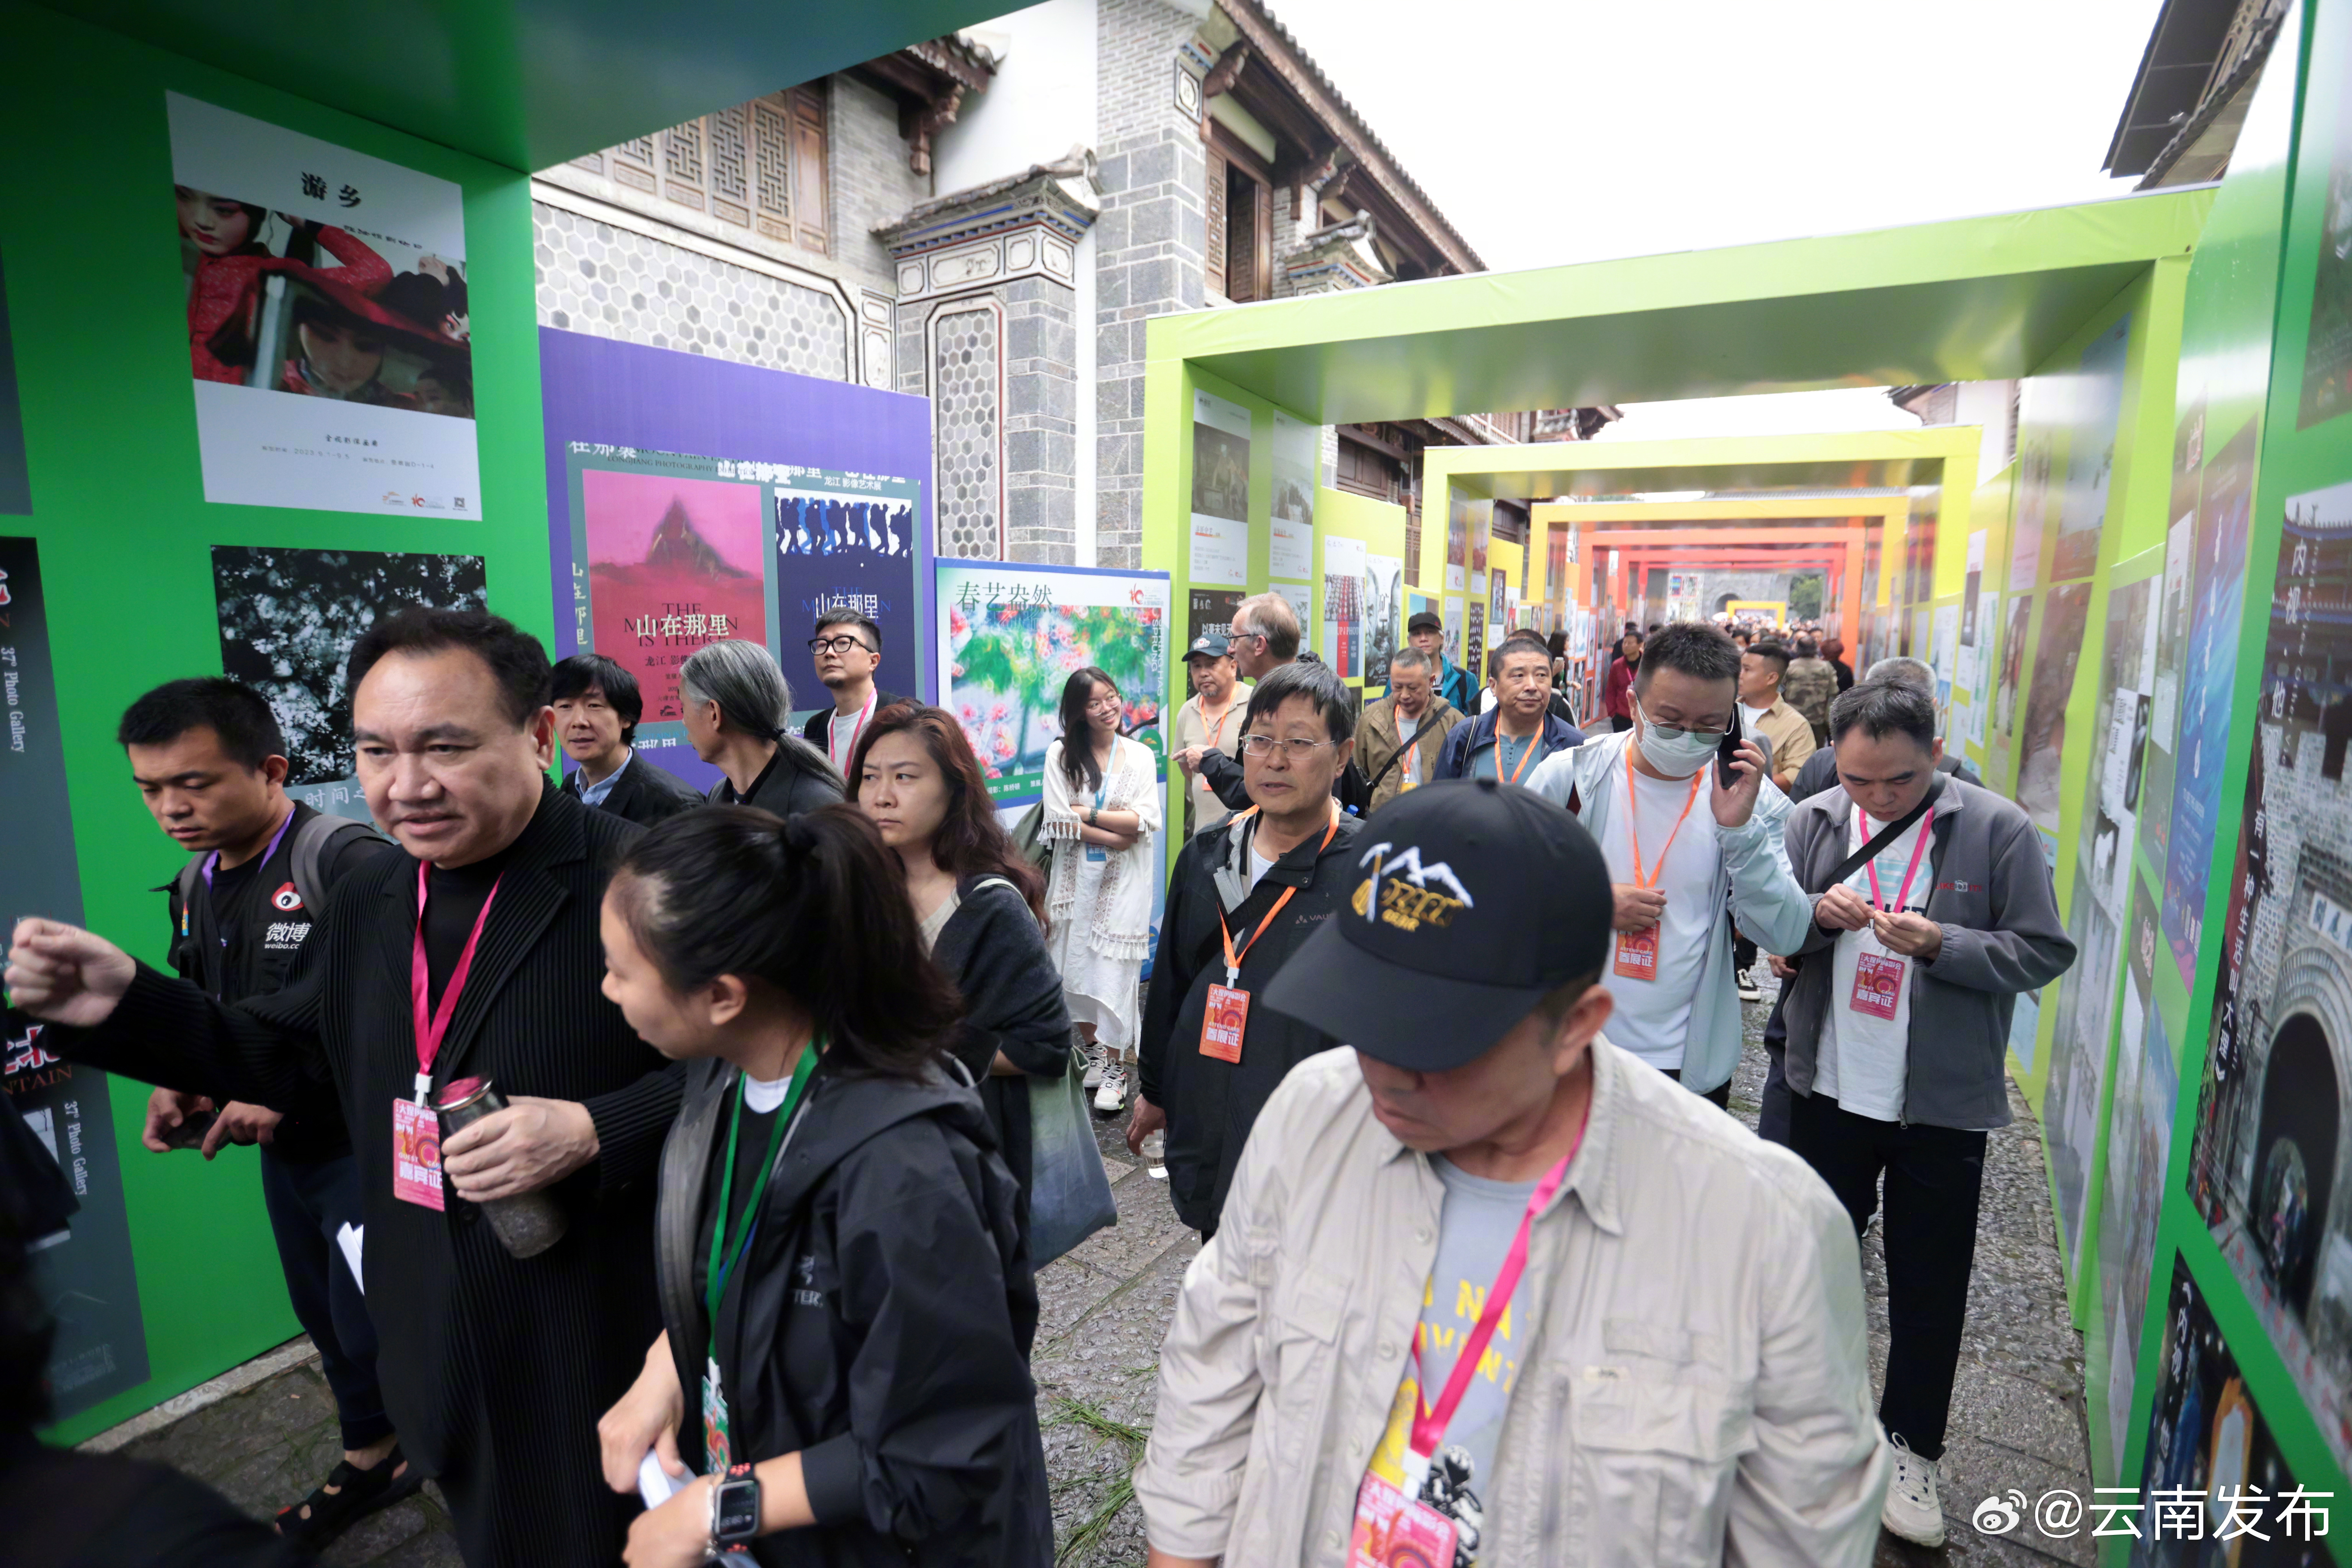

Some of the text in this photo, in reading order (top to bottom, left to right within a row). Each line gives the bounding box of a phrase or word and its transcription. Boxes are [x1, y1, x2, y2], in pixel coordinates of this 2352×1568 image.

[301, 171, 362, 208] 游乡
[607, 455, 653, 466] LONGJIANG
[655, 459, 714, 472] PHOTOGRAPHY
[824, 475, 882, 491] 龙江 影像艺术展
[956, 581, 1053, 613] 春艺盎然
[636, 613, 730, 638] 山在那里
[671, 655, 688, 666] 影像
[4, 671, 19, 706] Photo
[9, 711, 25, 753] Gallery
[305, 786, 367, 808] 时间之
[265, 922, 312, 942] 微博
[67, 1122, 83, 1155] Photo
[73, 1157, 88, 1195] Gallery
